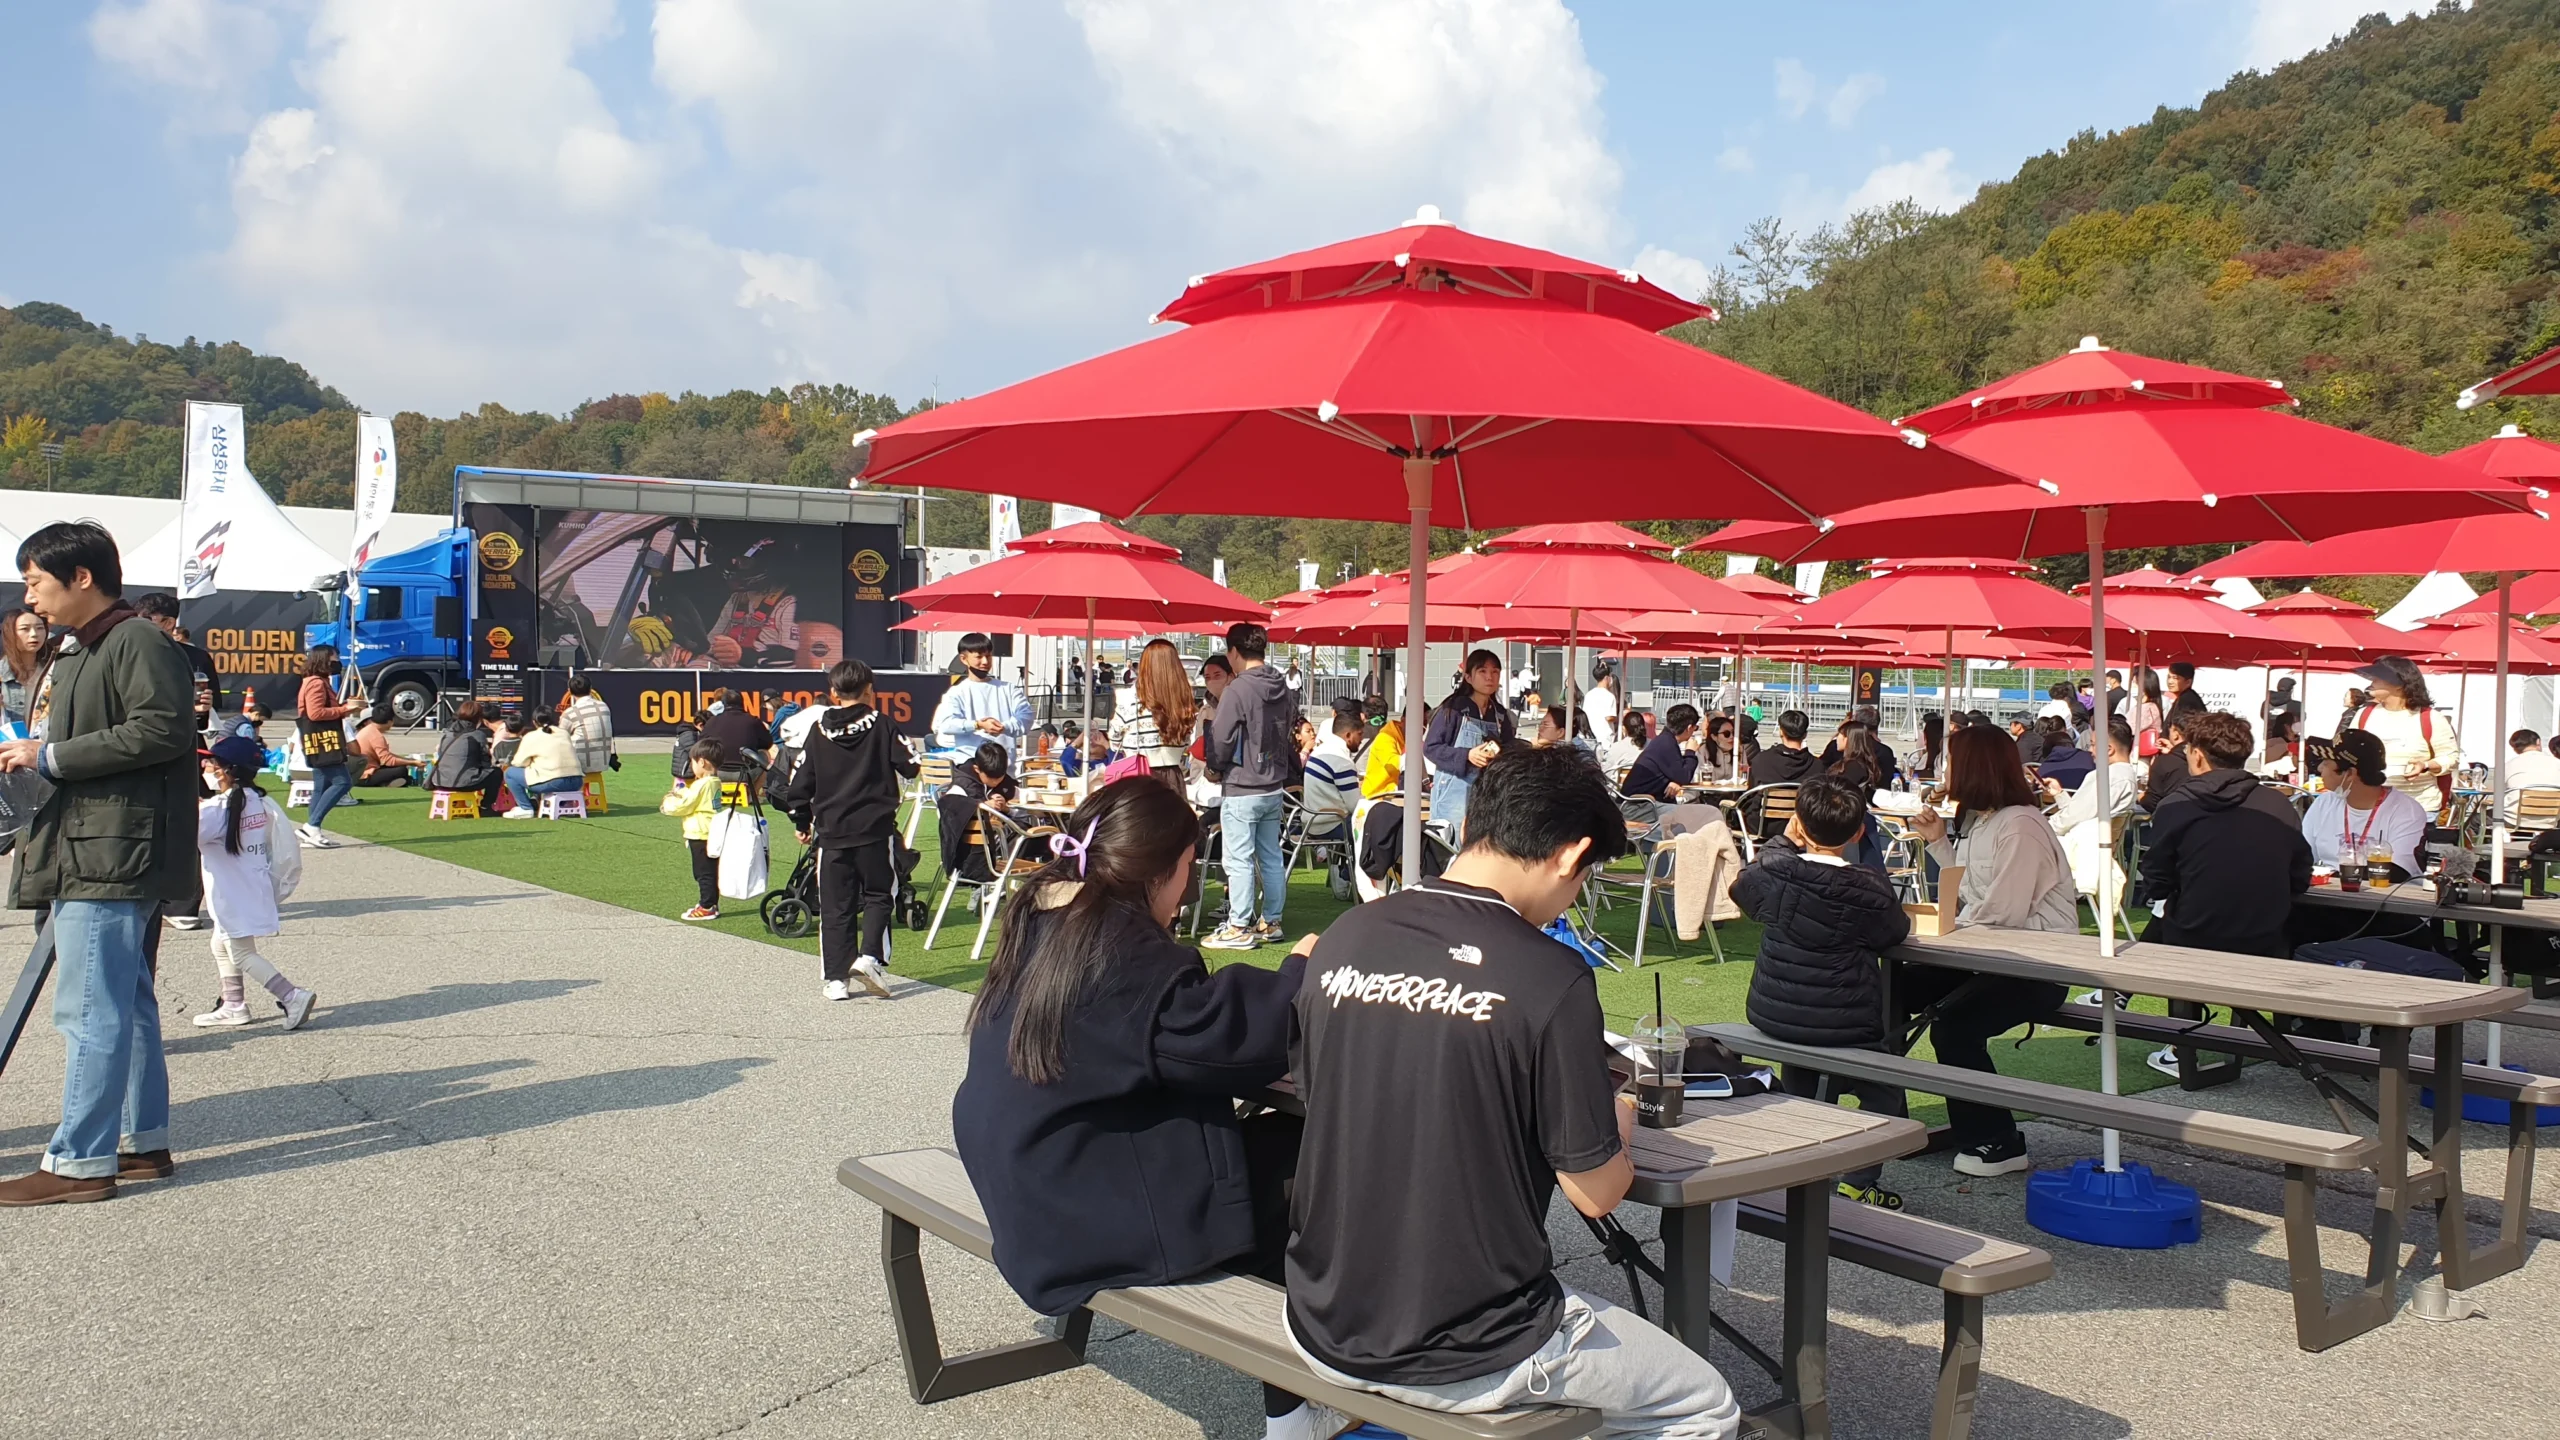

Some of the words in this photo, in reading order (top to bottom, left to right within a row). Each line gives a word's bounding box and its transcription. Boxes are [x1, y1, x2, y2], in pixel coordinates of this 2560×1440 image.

[210, 424, 228, 493] 삼성화재
[558, 521, 586, 530] KUMHO
[206, 628, 297, 652] GOLDEN
[480, 663, 497, 671] TIME
[1321, 965, 1506, 1021] #MOVEFORPEACE
